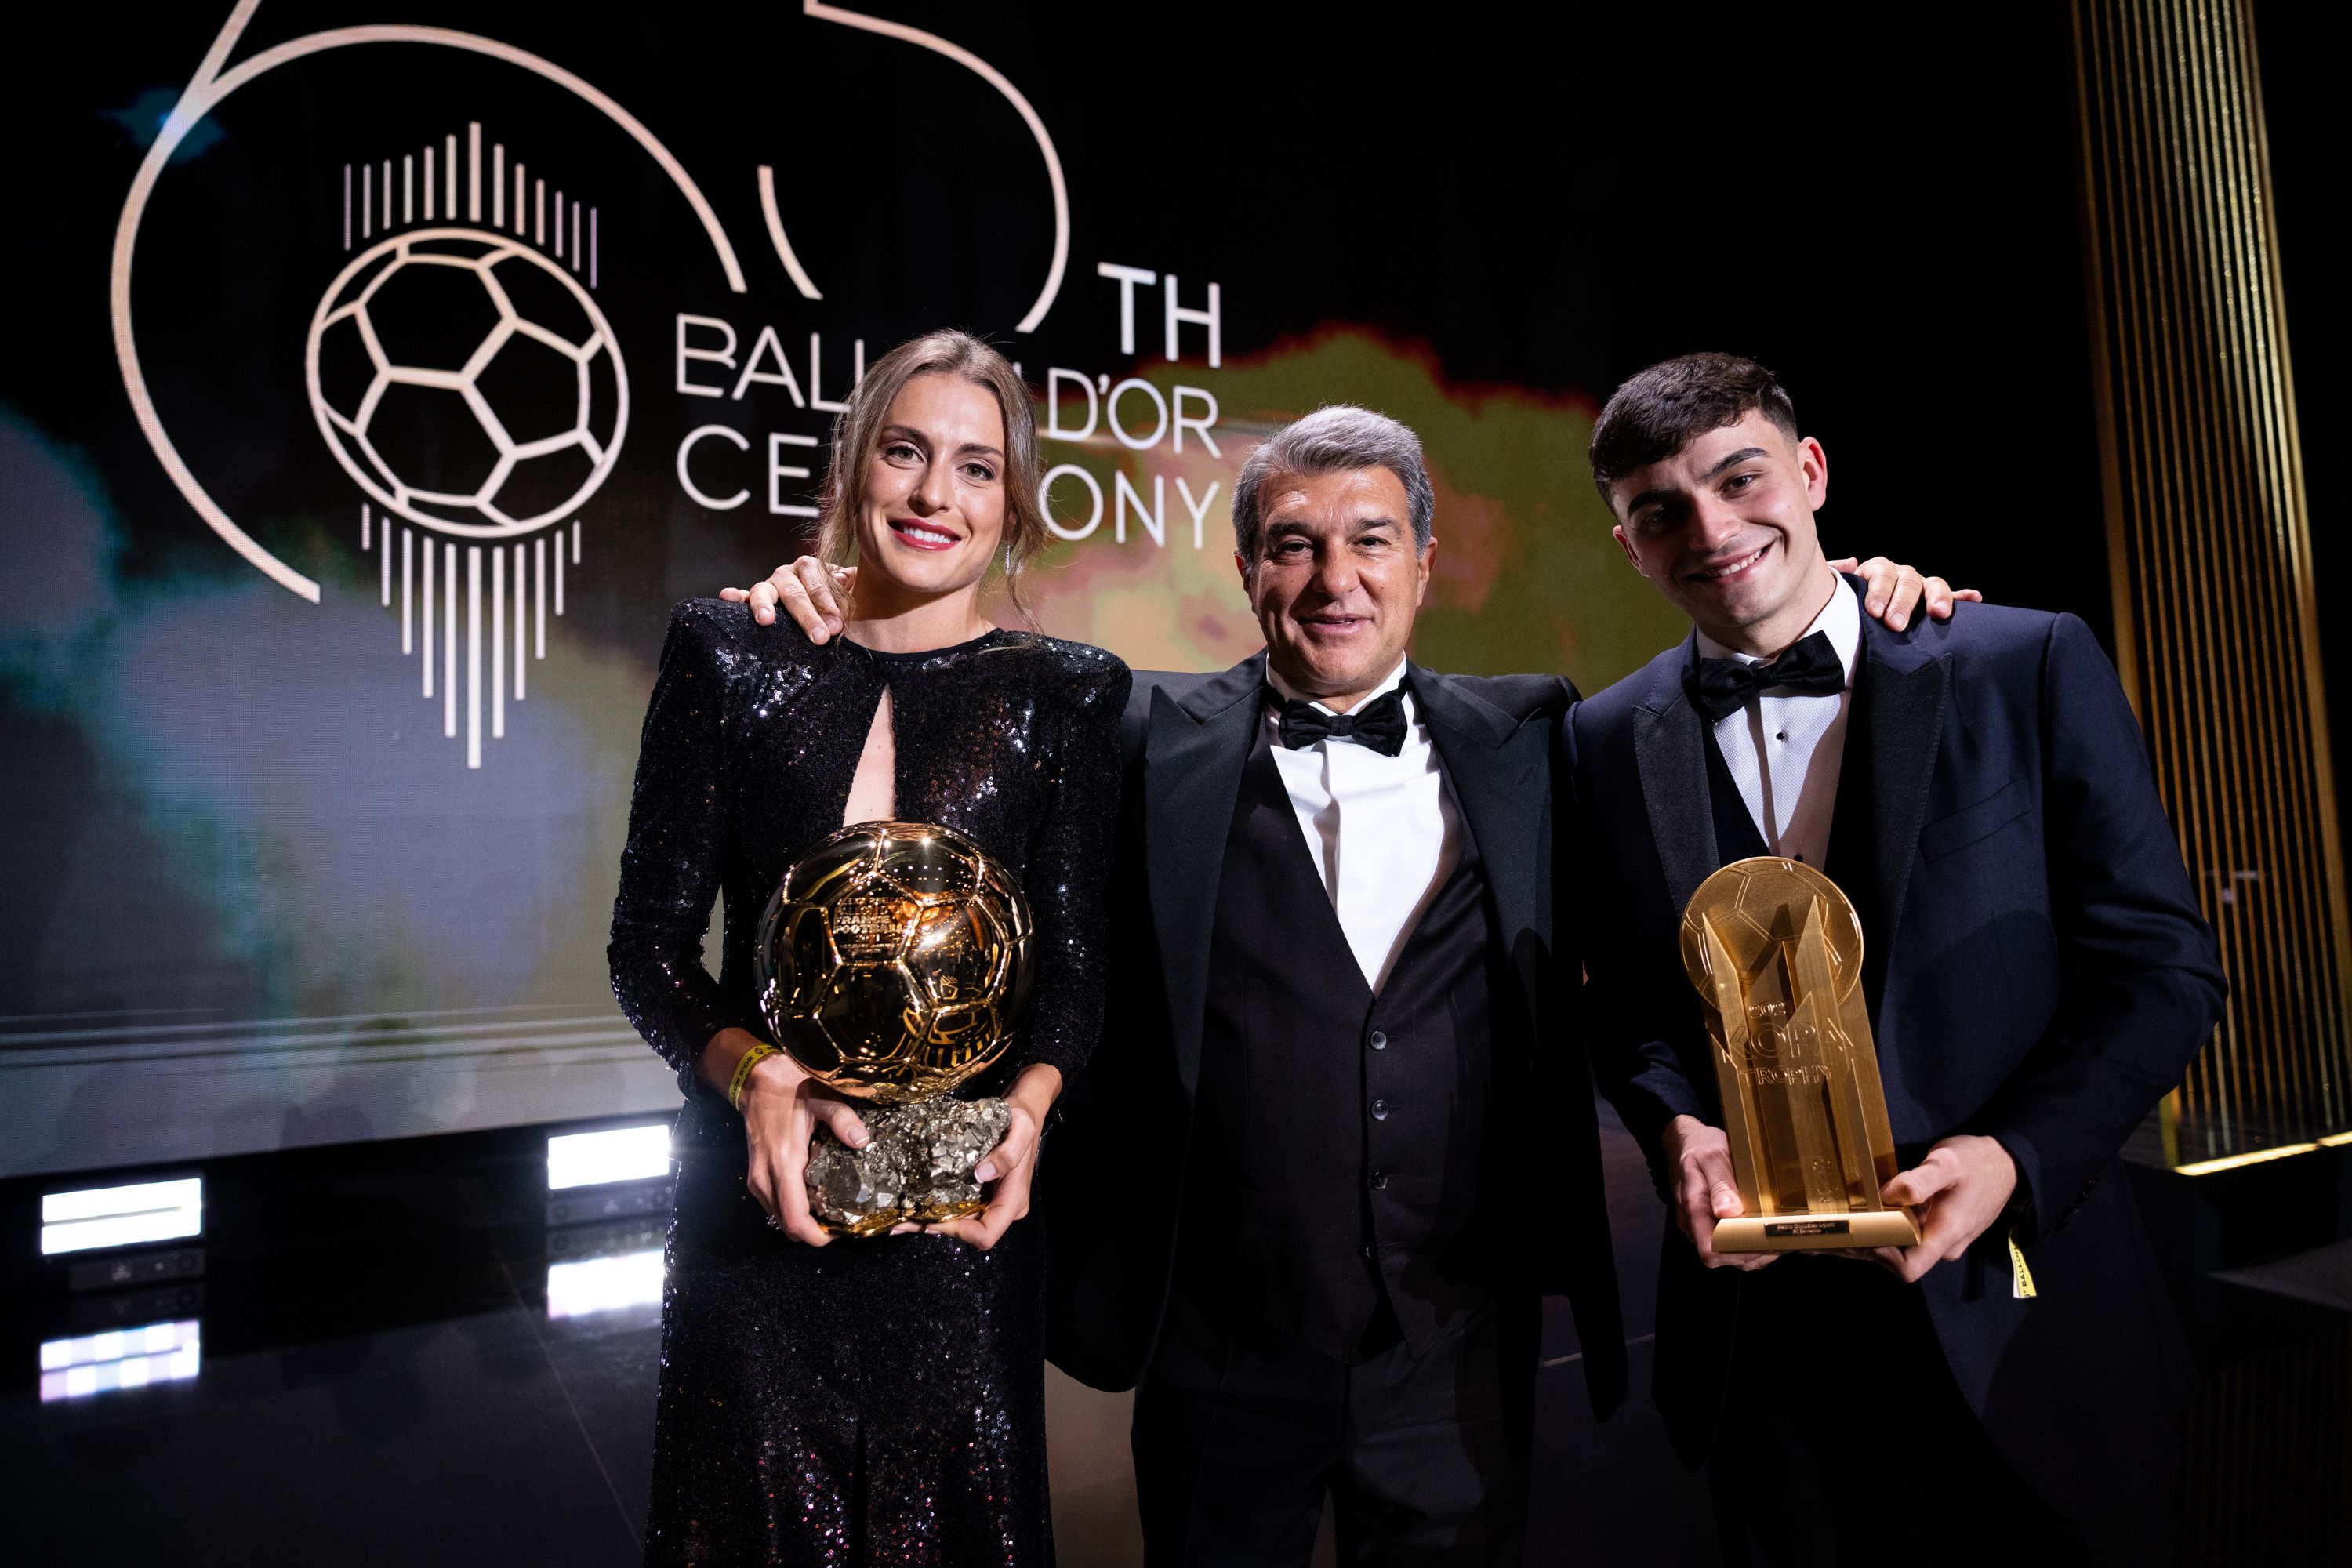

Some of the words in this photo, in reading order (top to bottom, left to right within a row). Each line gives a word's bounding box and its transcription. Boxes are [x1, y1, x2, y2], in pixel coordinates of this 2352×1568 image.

[1098, 261, 1221, 368] TH
[1047, 367, 1221, 459] D'OR
[676, 424, 1221, 550] CEONY
[833, 916, 890, 925] FRANCE
[1722, 1018, 1854, 1063] KOPA
[1740, 1063, 1833, 1087] TROPHY
